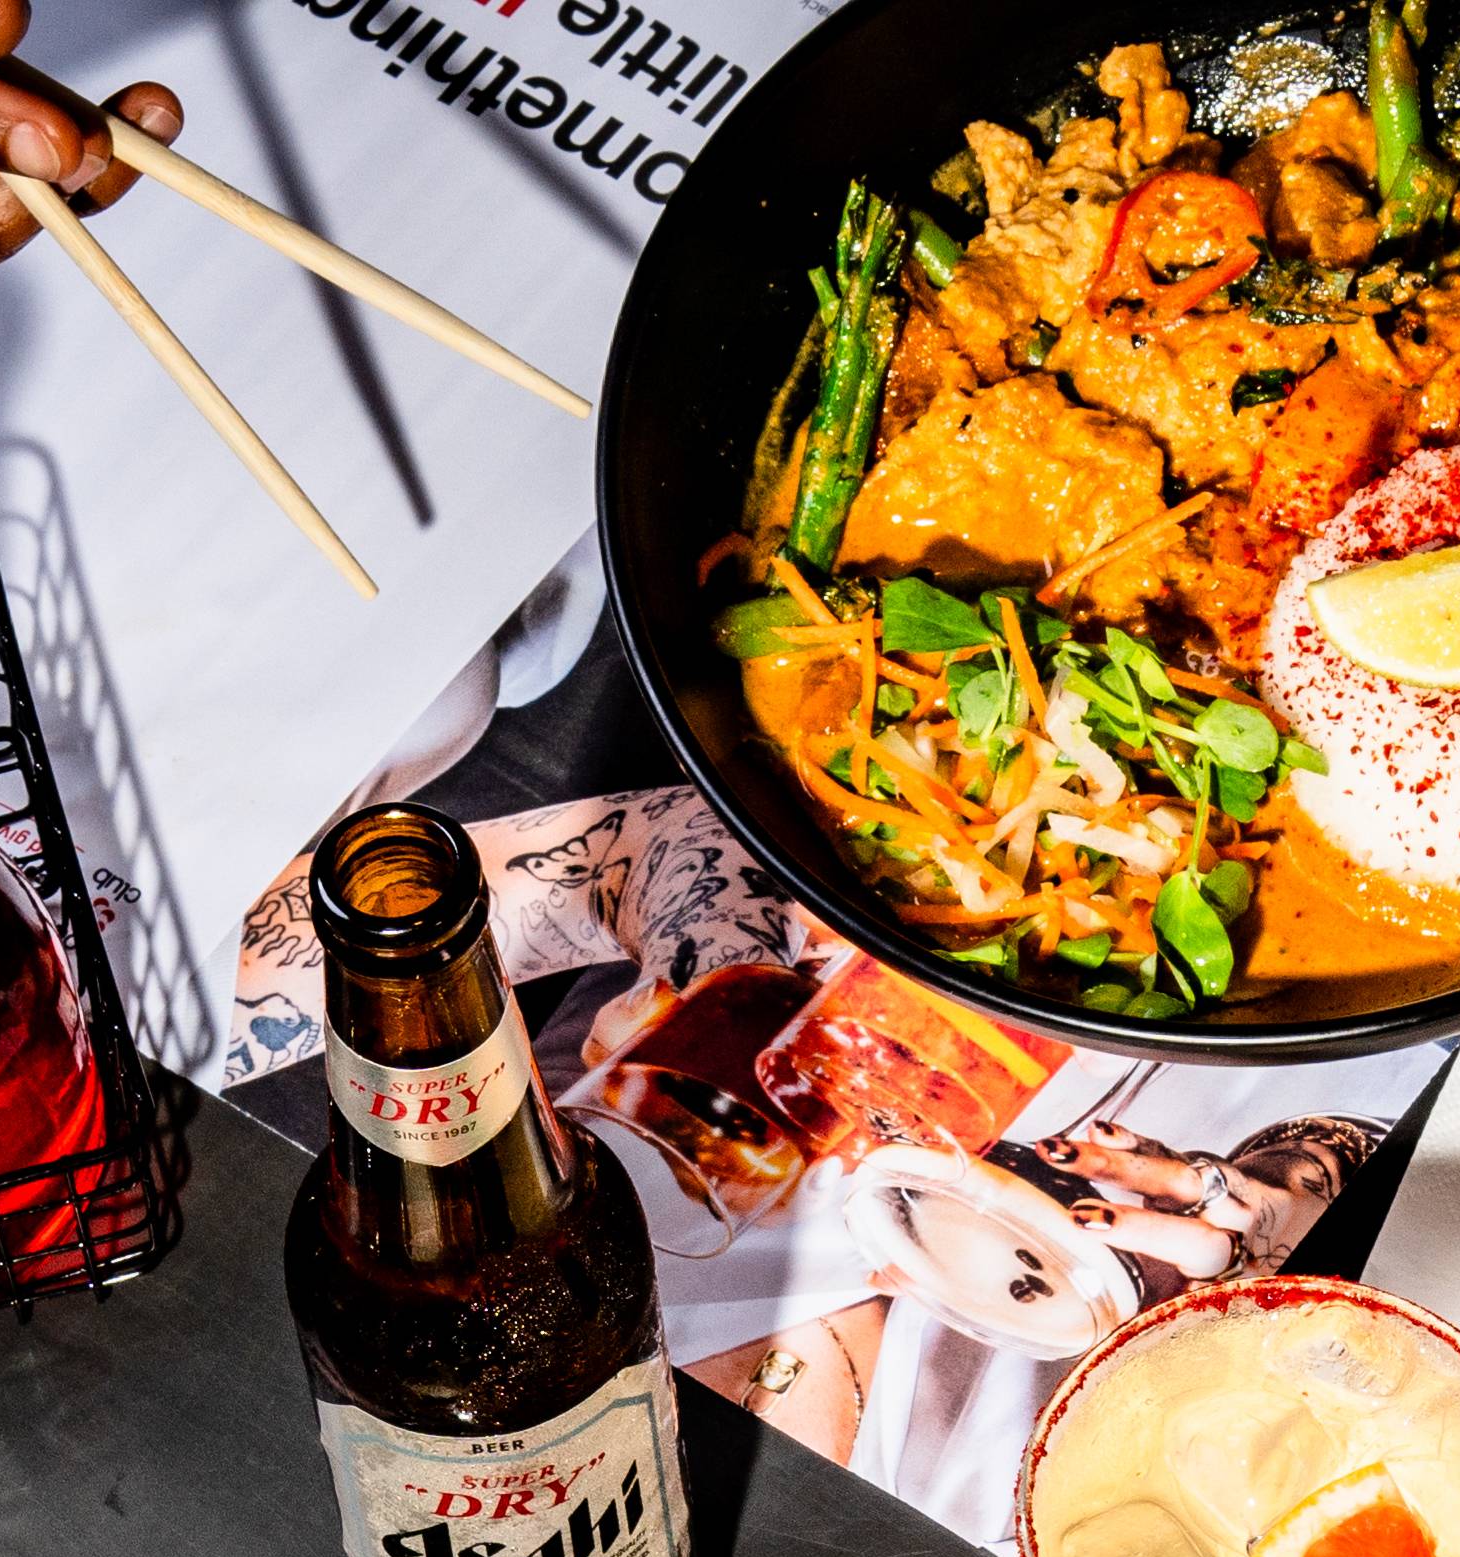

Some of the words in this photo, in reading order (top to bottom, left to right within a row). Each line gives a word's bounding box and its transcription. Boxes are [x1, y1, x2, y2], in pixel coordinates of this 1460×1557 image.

[558, 0, 749, 129] little
[292, 0, 695, 205] omethin
[92, 866, 142, 904] club
[390, 1071, 469, 1095] SUPER
[393, 1129, 440, 1141] SINCE
[444, 1120, 477, 1139] 1987
[471, 1439, 525, 1455] BEER
[461, 1464, 556, 1490] SUPER
